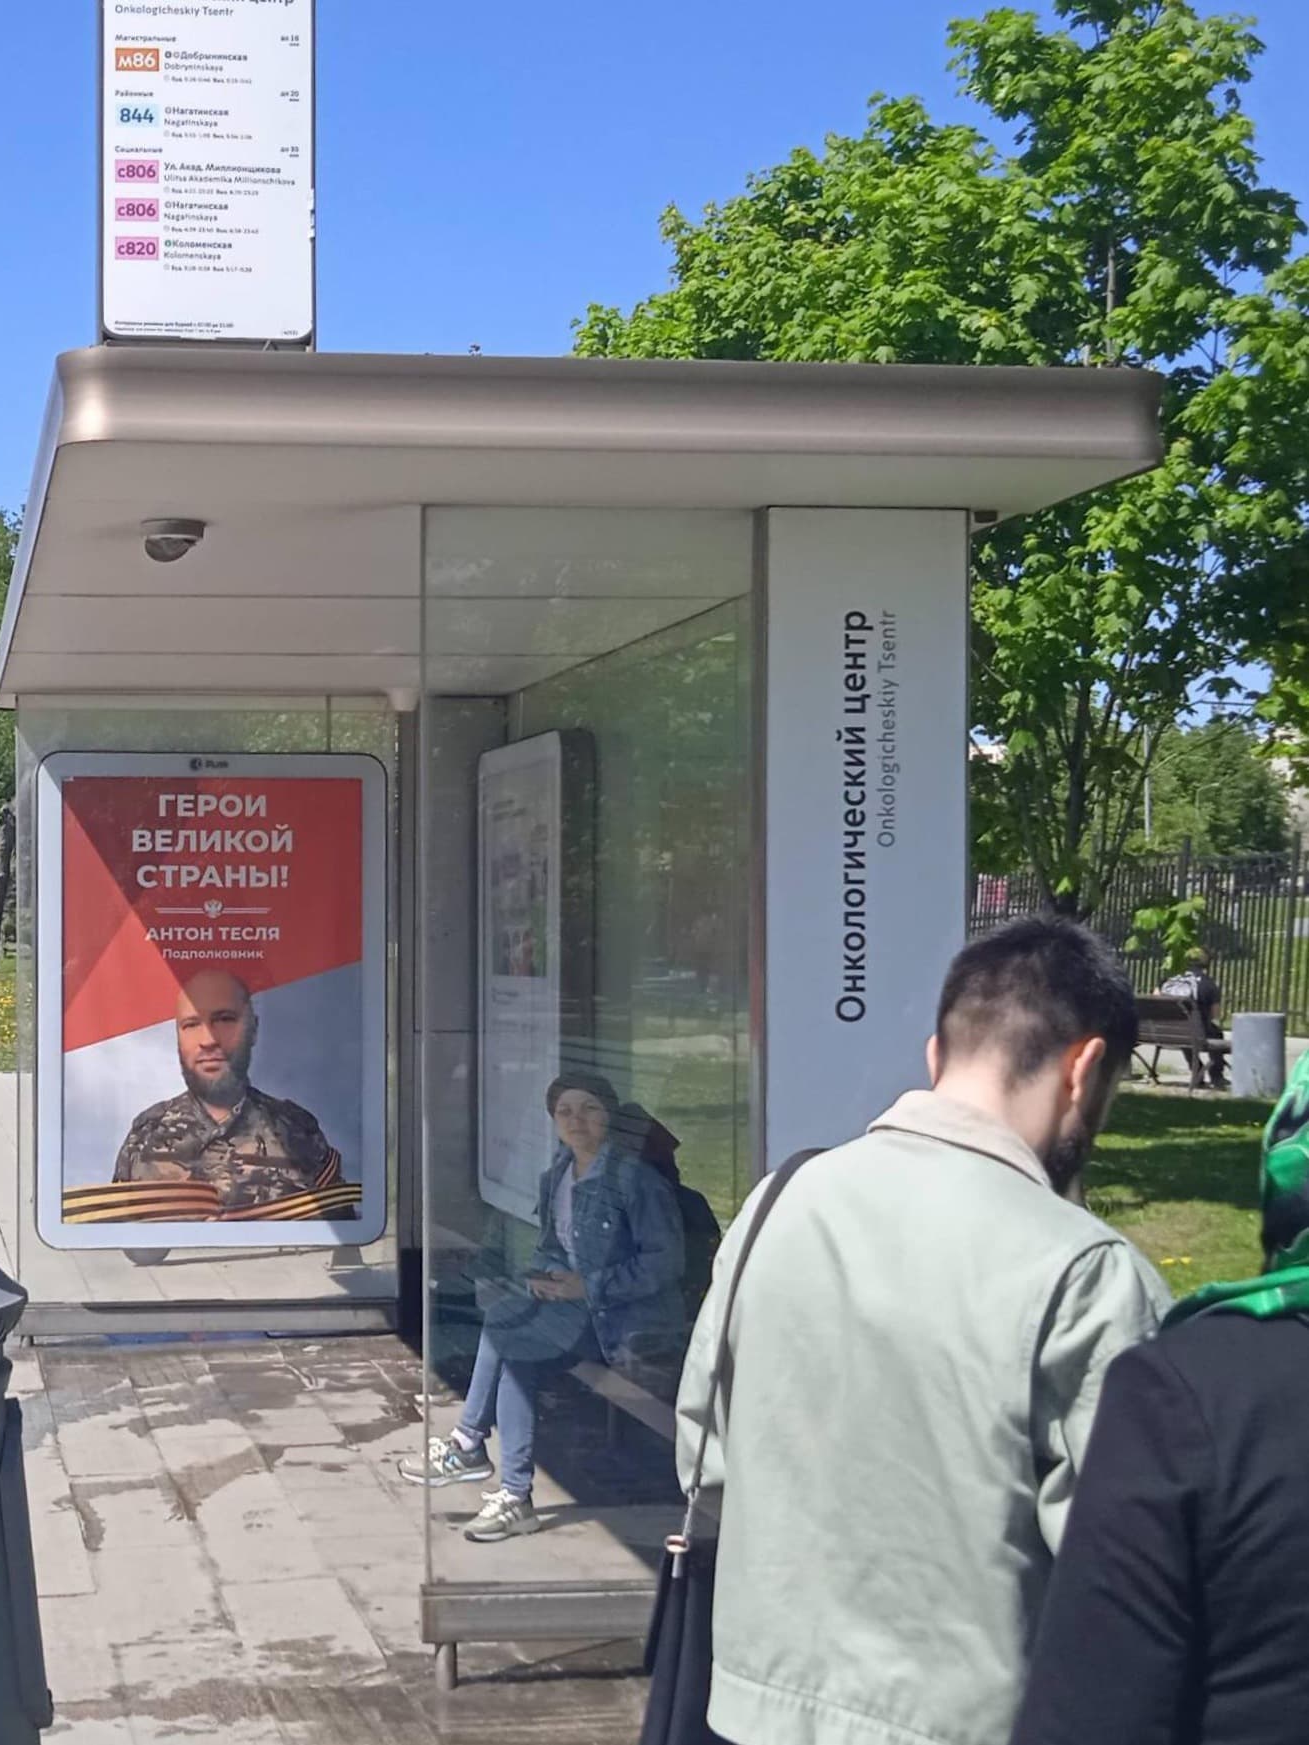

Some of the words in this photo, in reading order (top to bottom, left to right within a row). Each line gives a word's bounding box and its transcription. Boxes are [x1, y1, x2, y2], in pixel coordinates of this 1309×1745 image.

[115, 4, 199, 16] Onkologicheskiy
[202, 6, 234, 16] Tsentr
[115, 34, 177, 43] Магистральные
[180, 51, 248, 62] Добрынинская
[164, 62, 224, 72] Dobryninskaya
[120, 108, 155, 123] 844
[172, 107, 229, 116] Нагатинская
[164, 118, 218, 128] Nagatinskaya
[118, 165, 156, 179] с806
[205, 164, 281, 174] Миллионщикова
[164, 174, 187, 183] Ulitsa
[189, 174, 232, 184] Akademika
[118, 203, 156, 217] с806
[172, 202, 229, 211] Нагатинская
[164, 213, 218, 222] Nagatinskaya
[118, 243, 156, 255] с820
[172, 240, 232, 249] Коломенская
[164, 251, 221, 260] Kolomenskaya
[877, 608, 897, 673] Tsentr
[843, 609, 874, 714] центр
[877, 678, 901, 848] Onkologicheskiy
[158, 794, 267, 818] ГЕРОИ
[132, 823, 293, 852] ВЕЛИКОЙ
[136, 865, 288, 888] СТРАНЫ!
[835, 726, 867, 1024] Онкологический
[145, 927, 213, 941] АНТОН
[219, 927, 280, 941] ТЕСЛЯ
[163, 948, 264, 960] Подполковник
